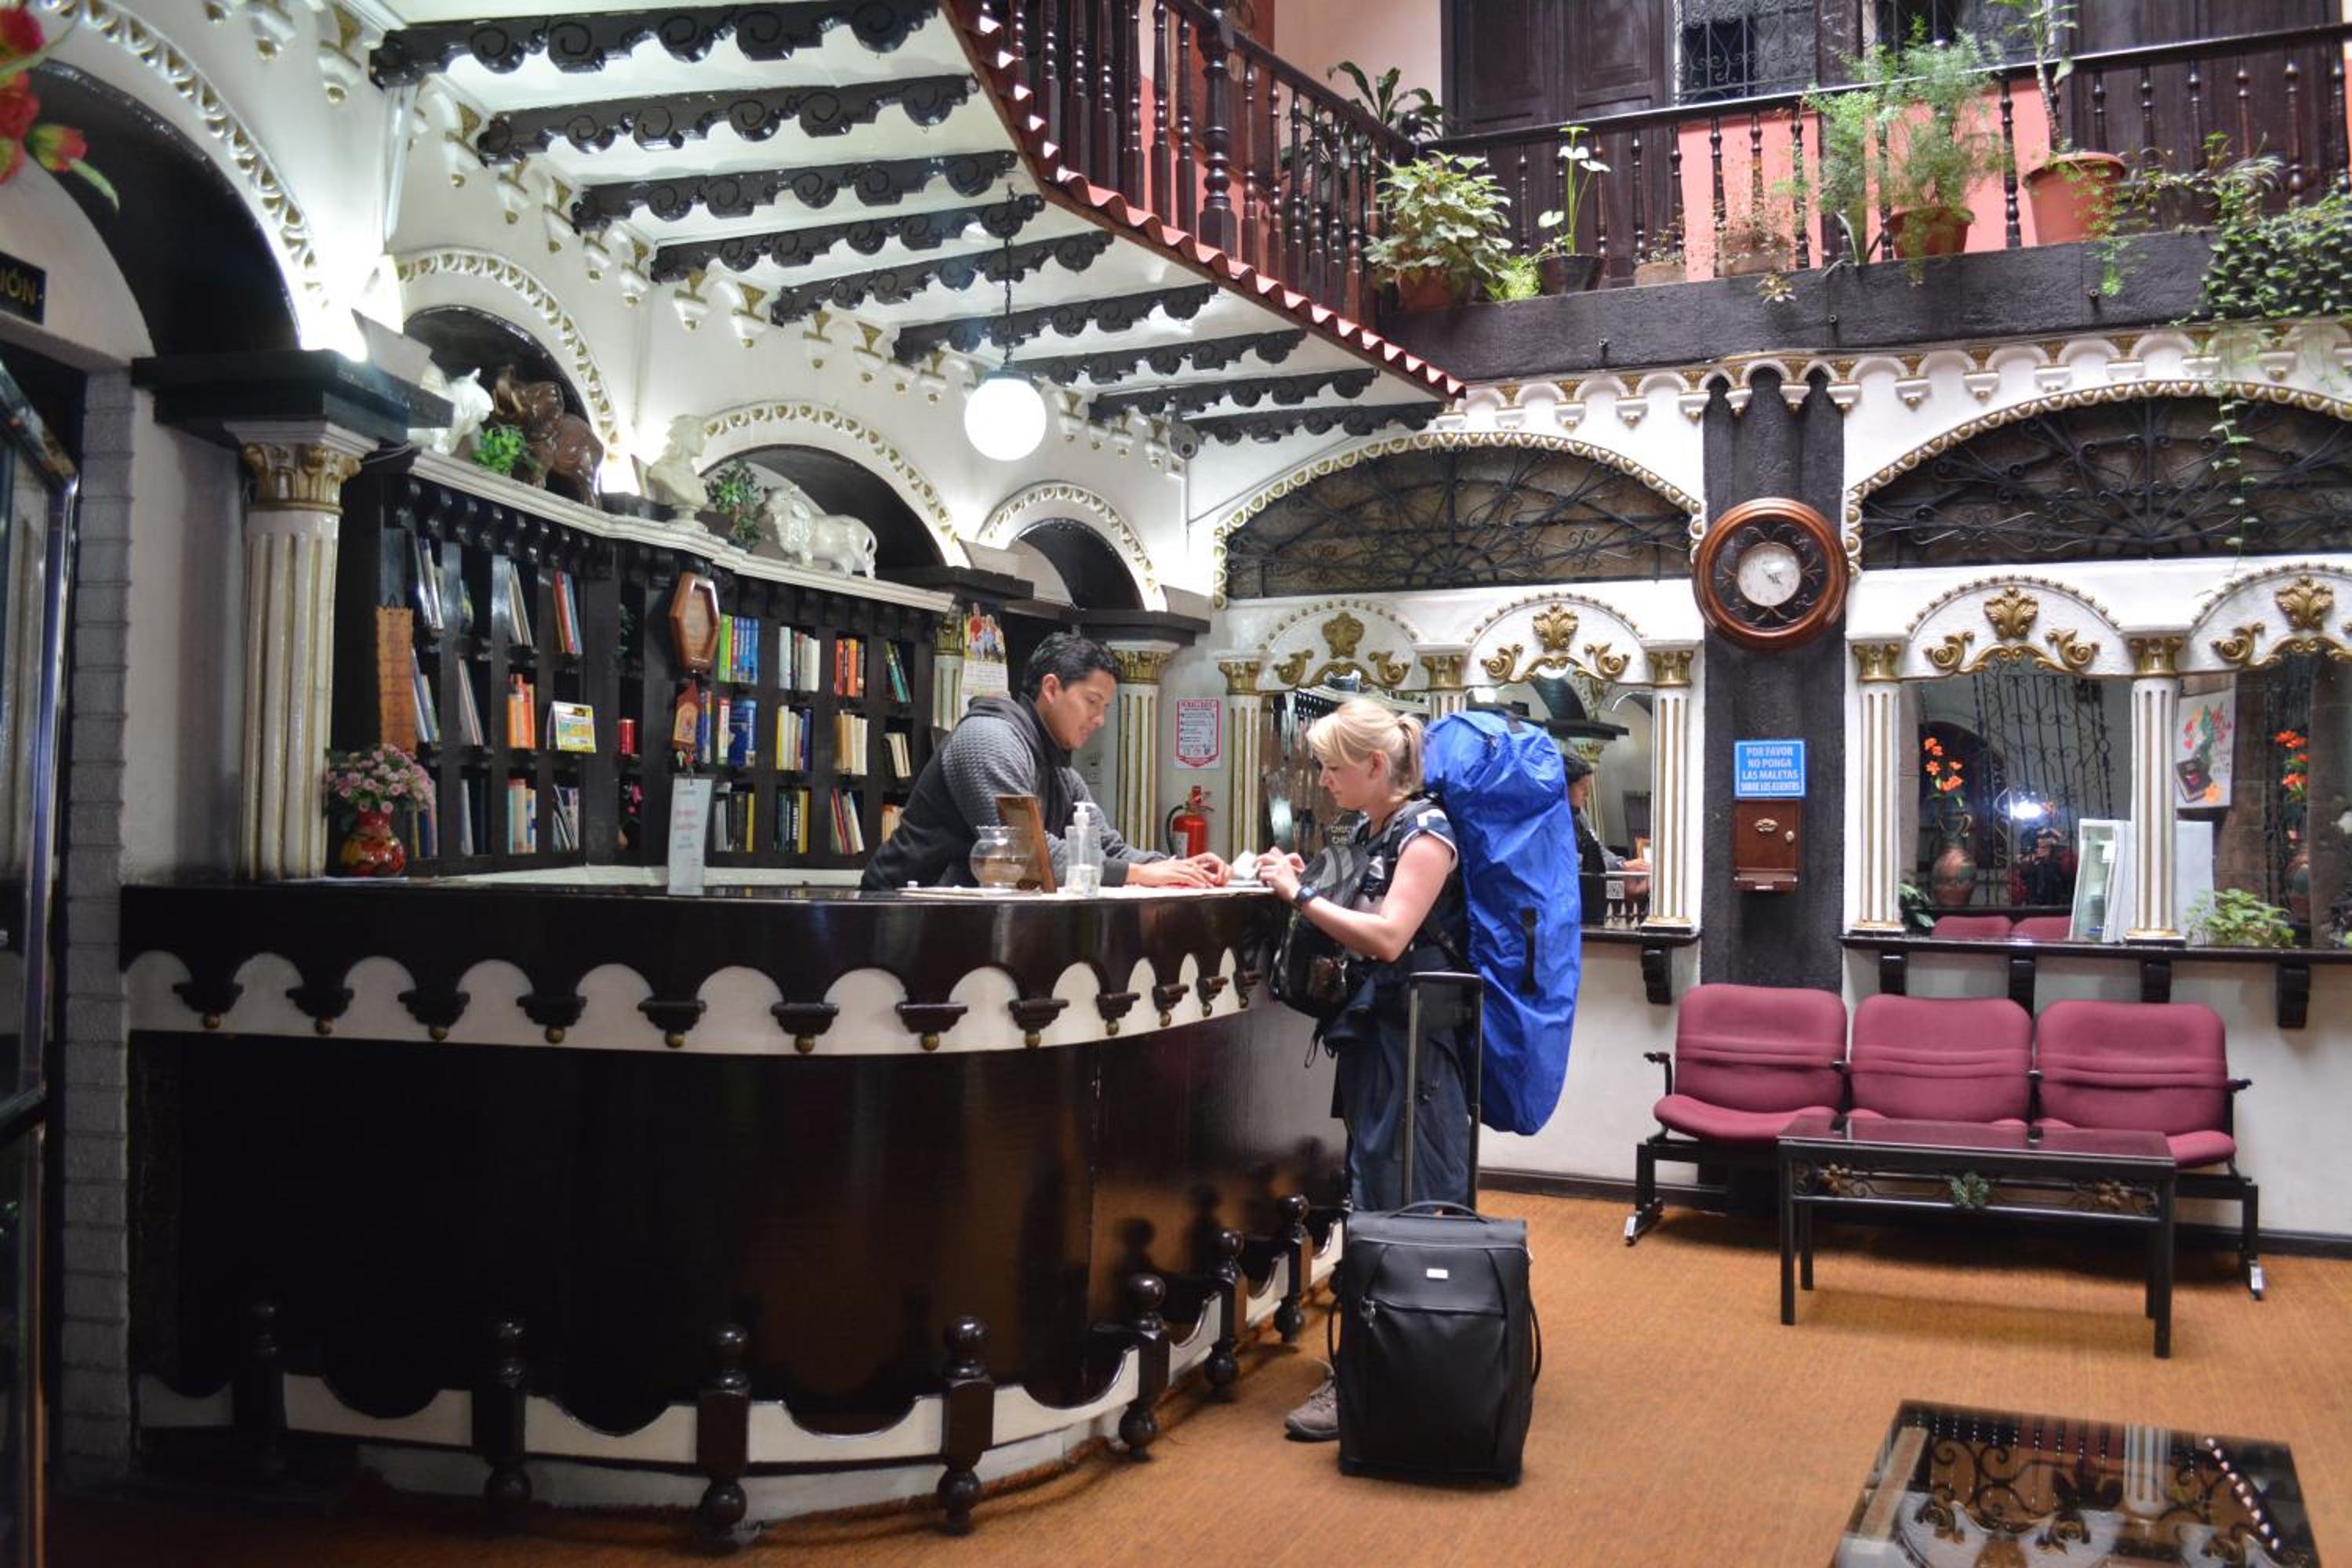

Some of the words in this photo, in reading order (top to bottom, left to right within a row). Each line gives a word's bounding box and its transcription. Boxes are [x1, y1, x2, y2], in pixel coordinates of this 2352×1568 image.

[1746, 746, 1763, 757] POR
[1765, 746, 1793, 756] FAVOR
[1748, 758, 1761, 768] NO
[1762, 758, 1792, 768] PONGA
[1742, 770, 1759, 779] LAS
[1759, 769, 1798, 779] MALETAS
